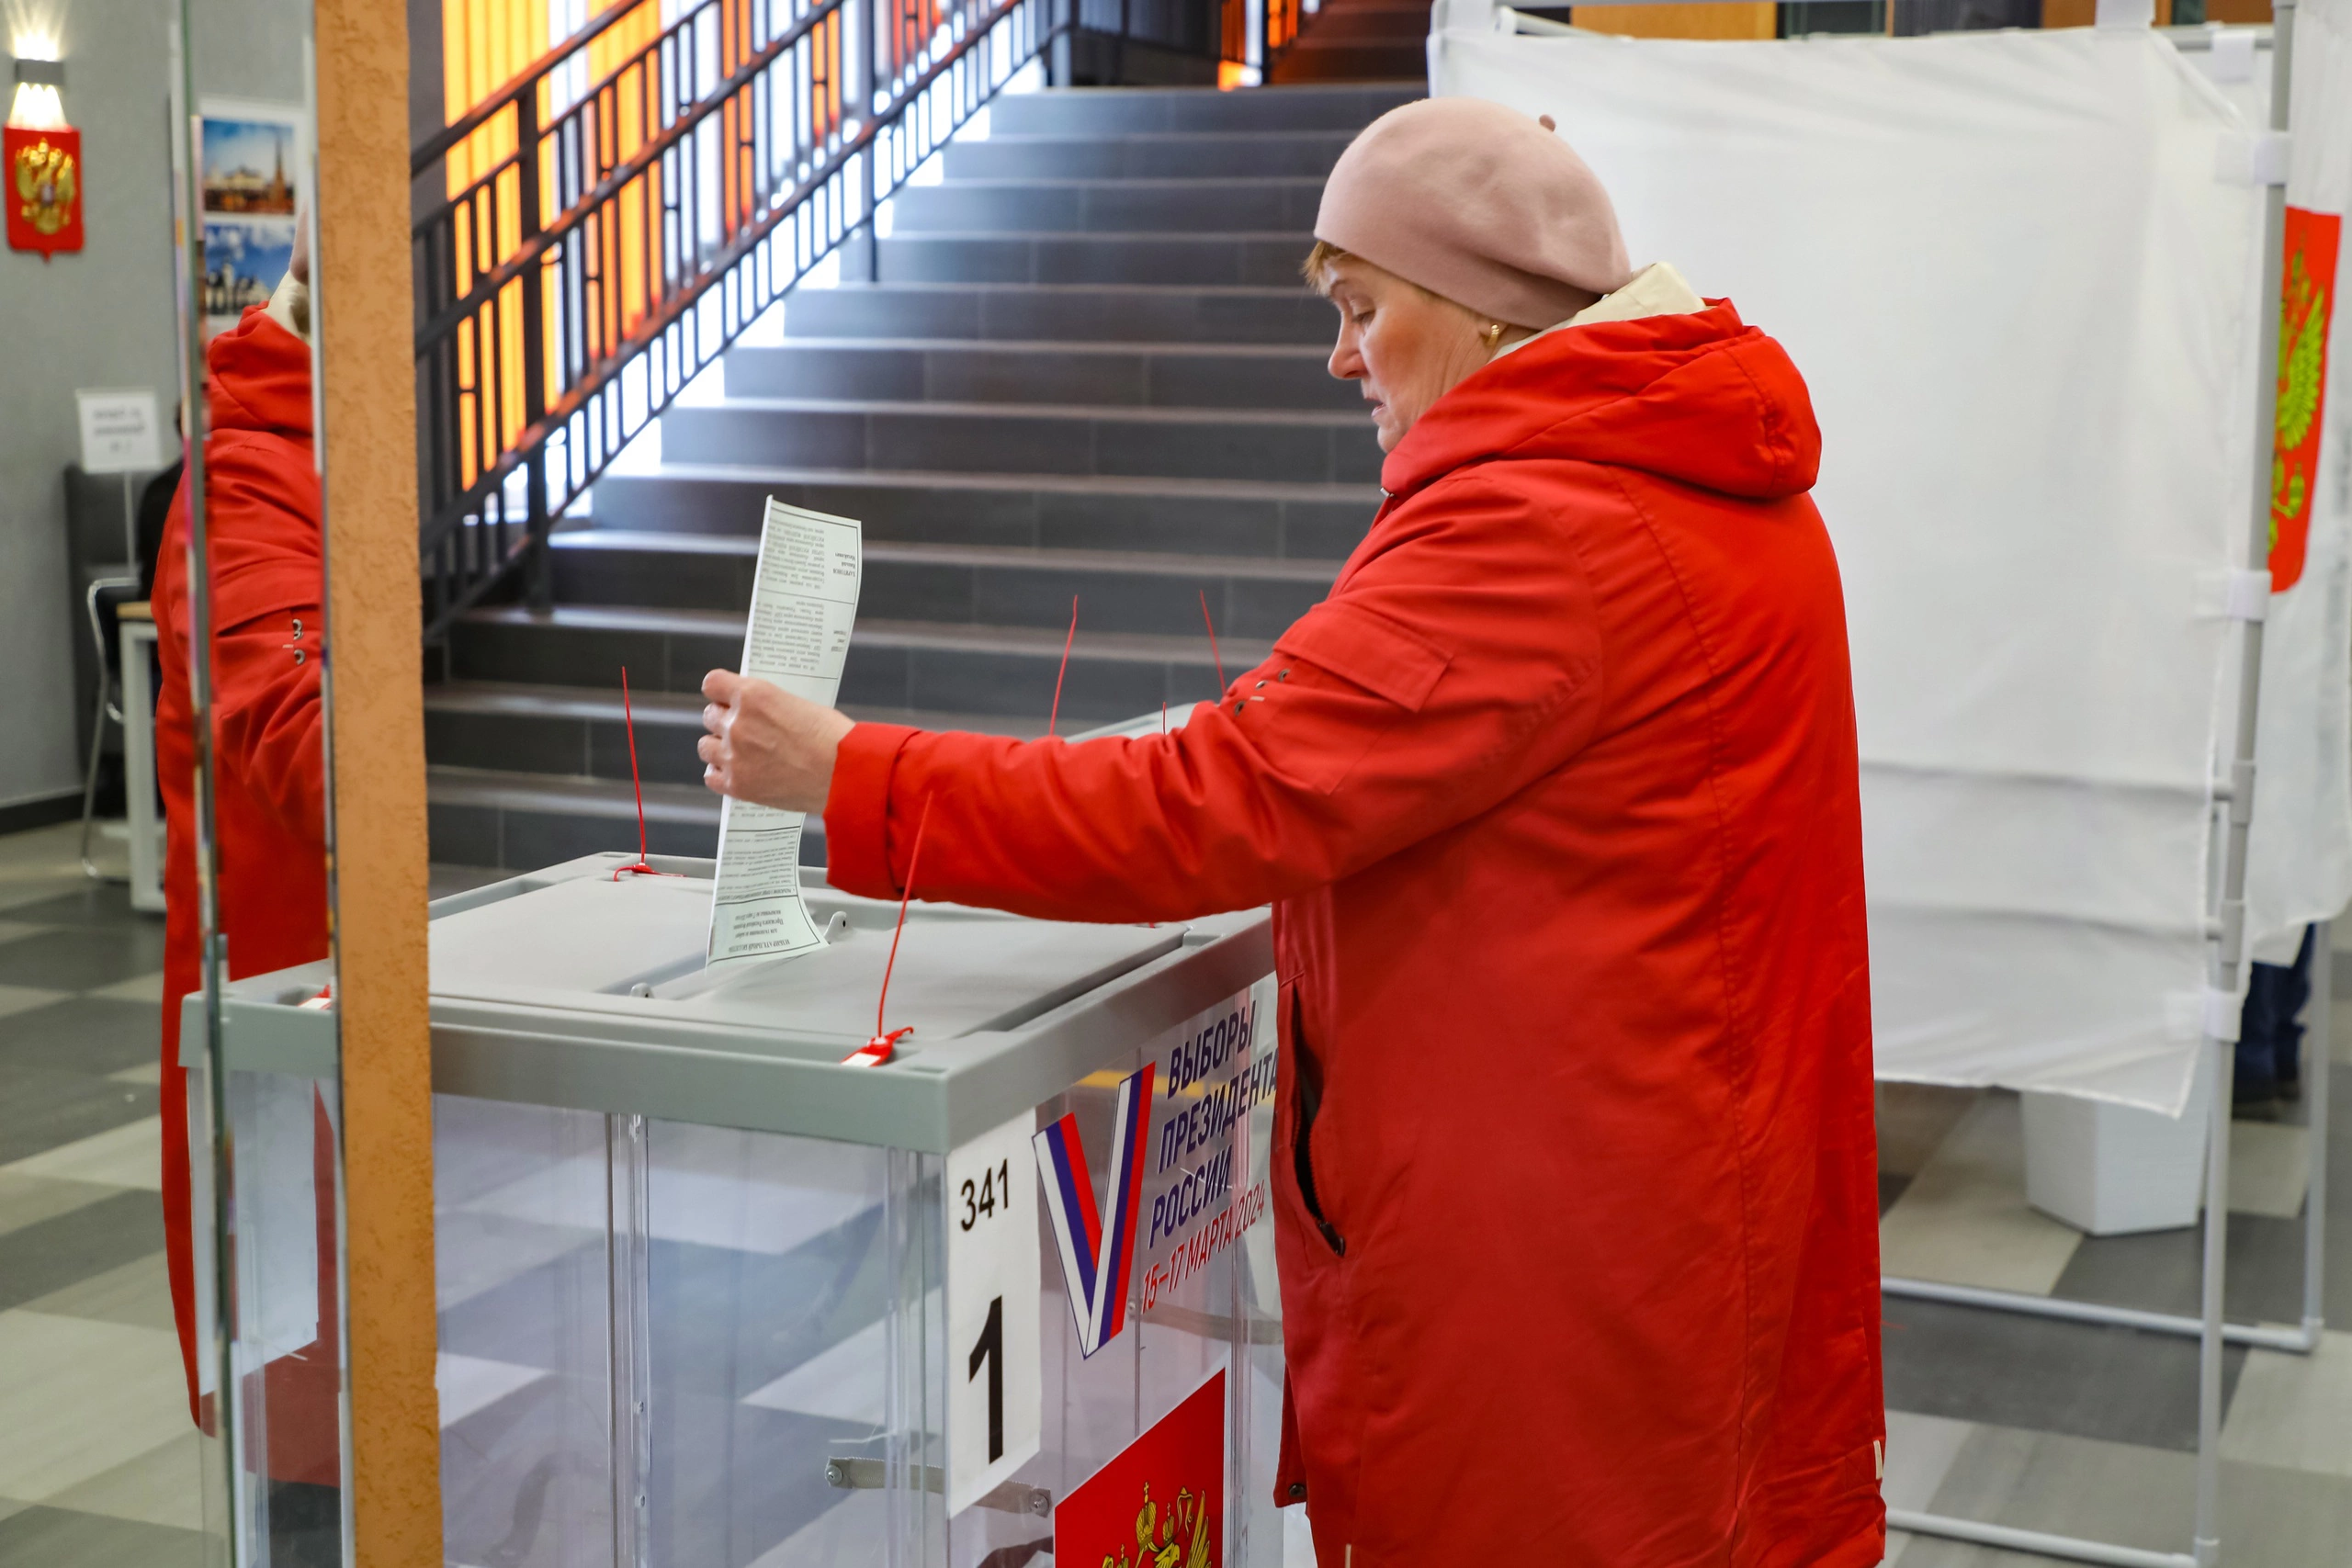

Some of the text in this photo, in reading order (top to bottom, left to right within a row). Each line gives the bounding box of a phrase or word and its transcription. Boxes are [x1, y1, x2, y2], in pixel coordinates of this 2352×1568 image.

[1167, 998, 1257, 1100] ВЫБОРЫ
[1159, 1047, 1278, 1175] ПРЕЗИДЕНТА
[960, 1157, 1009, 1233] 341
[1148, 1145, 1233, 1249] РОССИИ
[1184, 1205, 1233, 1280] МАРТА
[1234, 1179, 1266, 1238] 2024
[968, 1294, 1004, 1465] 1
